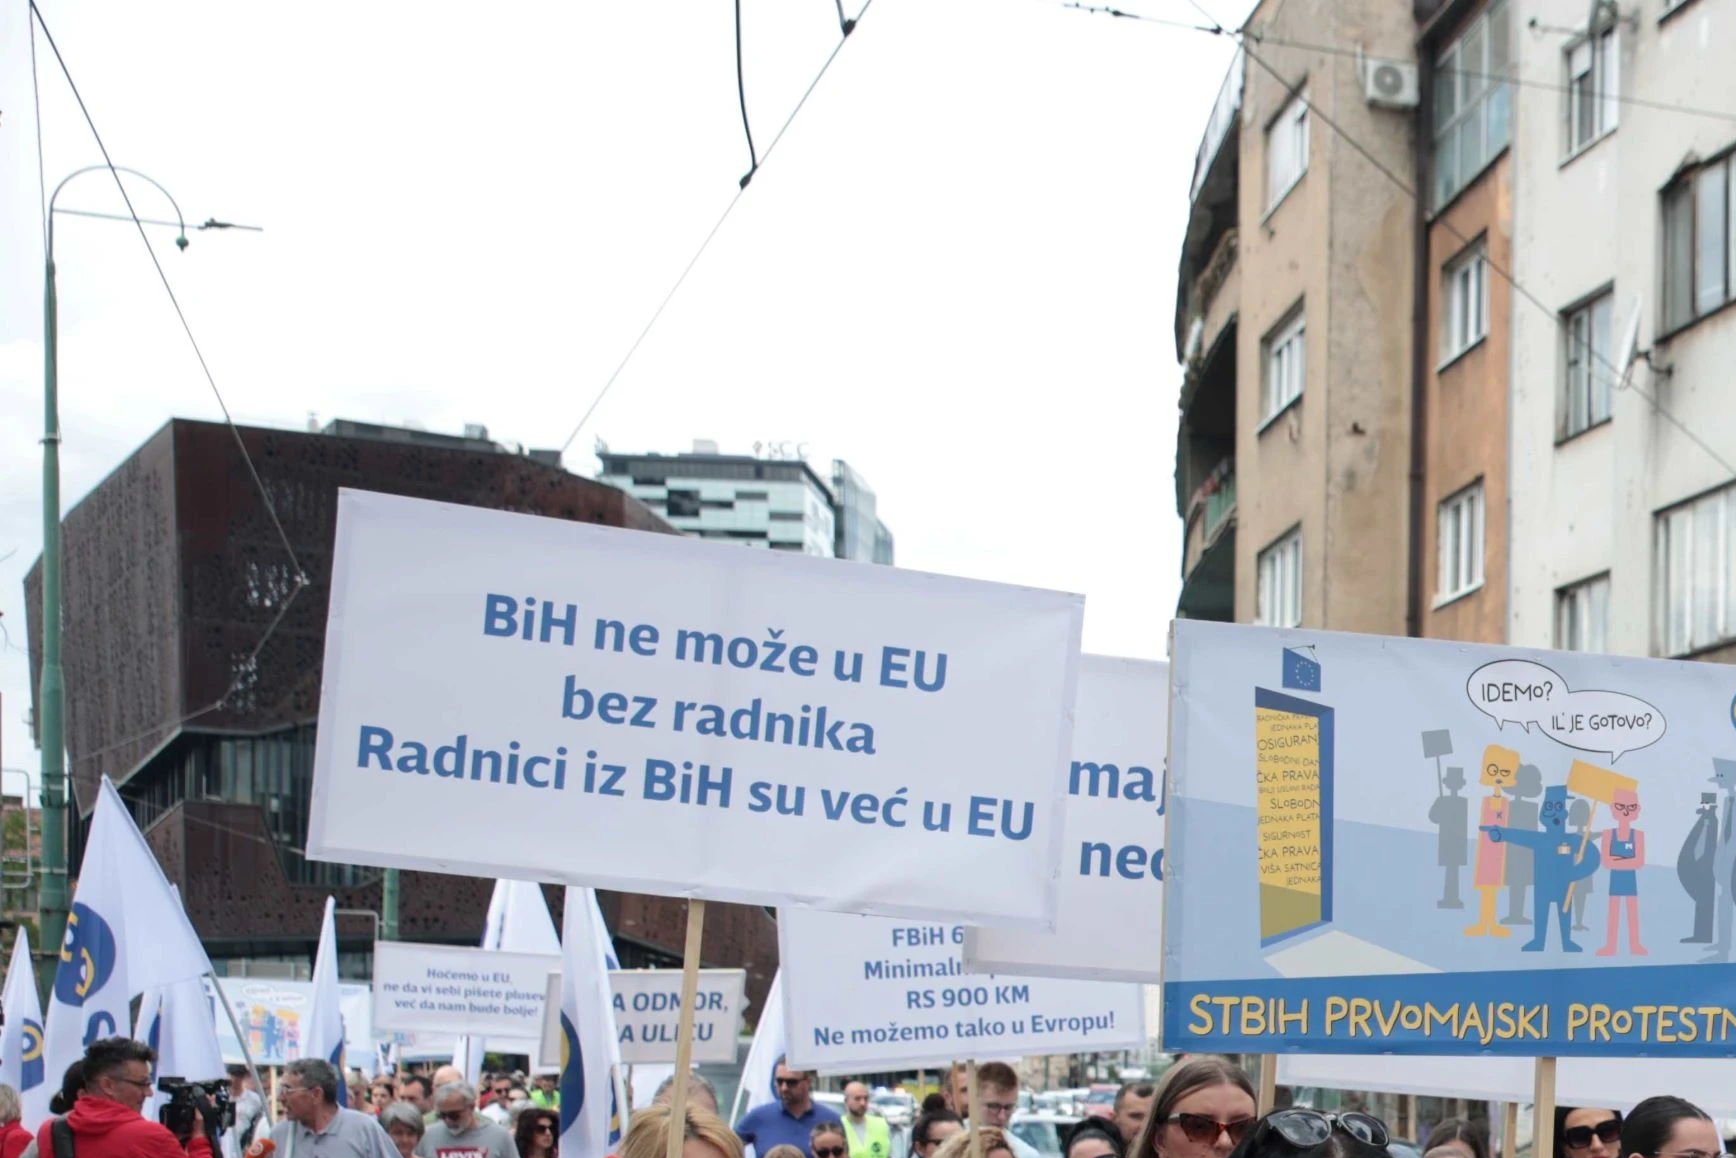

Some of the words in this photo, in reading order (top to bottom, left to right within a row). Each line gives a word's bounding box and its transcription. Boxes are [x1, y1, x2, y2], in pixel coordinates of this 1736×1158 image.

[483, 593, 578, 646] BiH
[594, 618, 660, 657] ne
[675, 627, 820, 677] može
[833, 651, 864, 683] u
[879, 645, 948, 693] EU
[1481, 681, 1553, 702] IDEMO?
[561, 674, 658, 729] bez
[672, 697, 876, 755] radnika
[1569, 714, 1584, 733] JE
[1589, 712, 1653, 731] GOTOVO?
[357, 724, 568, 790] Radnici
[583, 749, 627, 797] iz
[642, 758, 733, 809] BiH
[747, 781, 806, 817] su
[820, 786, 909, 828] već
[922, 800, 952, 833] u
[967, 795, 1035, 841] EU
[1282, 768, 1320, 781] PRAVA
[1282, 844, 1320, 857] PRAVA
[891, 926, 945, 947] FBiH
[427, 968, 478, 982] Hoćemo
[481, 973, 489, 982] u
[383, 983, 399, 992] ne
[402, 982, 418, 993] da
[421, 983, 432, 993] vi
[435, 984, 461, 996] sebi
[463, 986, 502, 1000] pišete
[906, 989, 936, 1010] RS
[941, 986, 989, 1008] 900
[995, 984, 1030, 1005] KM
[394, 1000, 415, 1009] već
[419, 1000, 436, 1011] da
[438, 1003, 466, 1013] nam
[469, 1003, 501, 1014] bude
[503, 1006, 538, 1019] bolje!
[1187, 992, 1309, 1036] STBIH
[1324, 995, 1550, 1045] PRVOMAJSKI
[641, 1022, 714, 1043] ULIU
[813, 1027, 845, 1047] Ne
[851, 1022, 949, 1045] možemo
[955, 1017, 1006, 1038] tako
[1011, 1020, 1025, 1035] u
[1031, 1010, 1115, 1037] Evropu!
